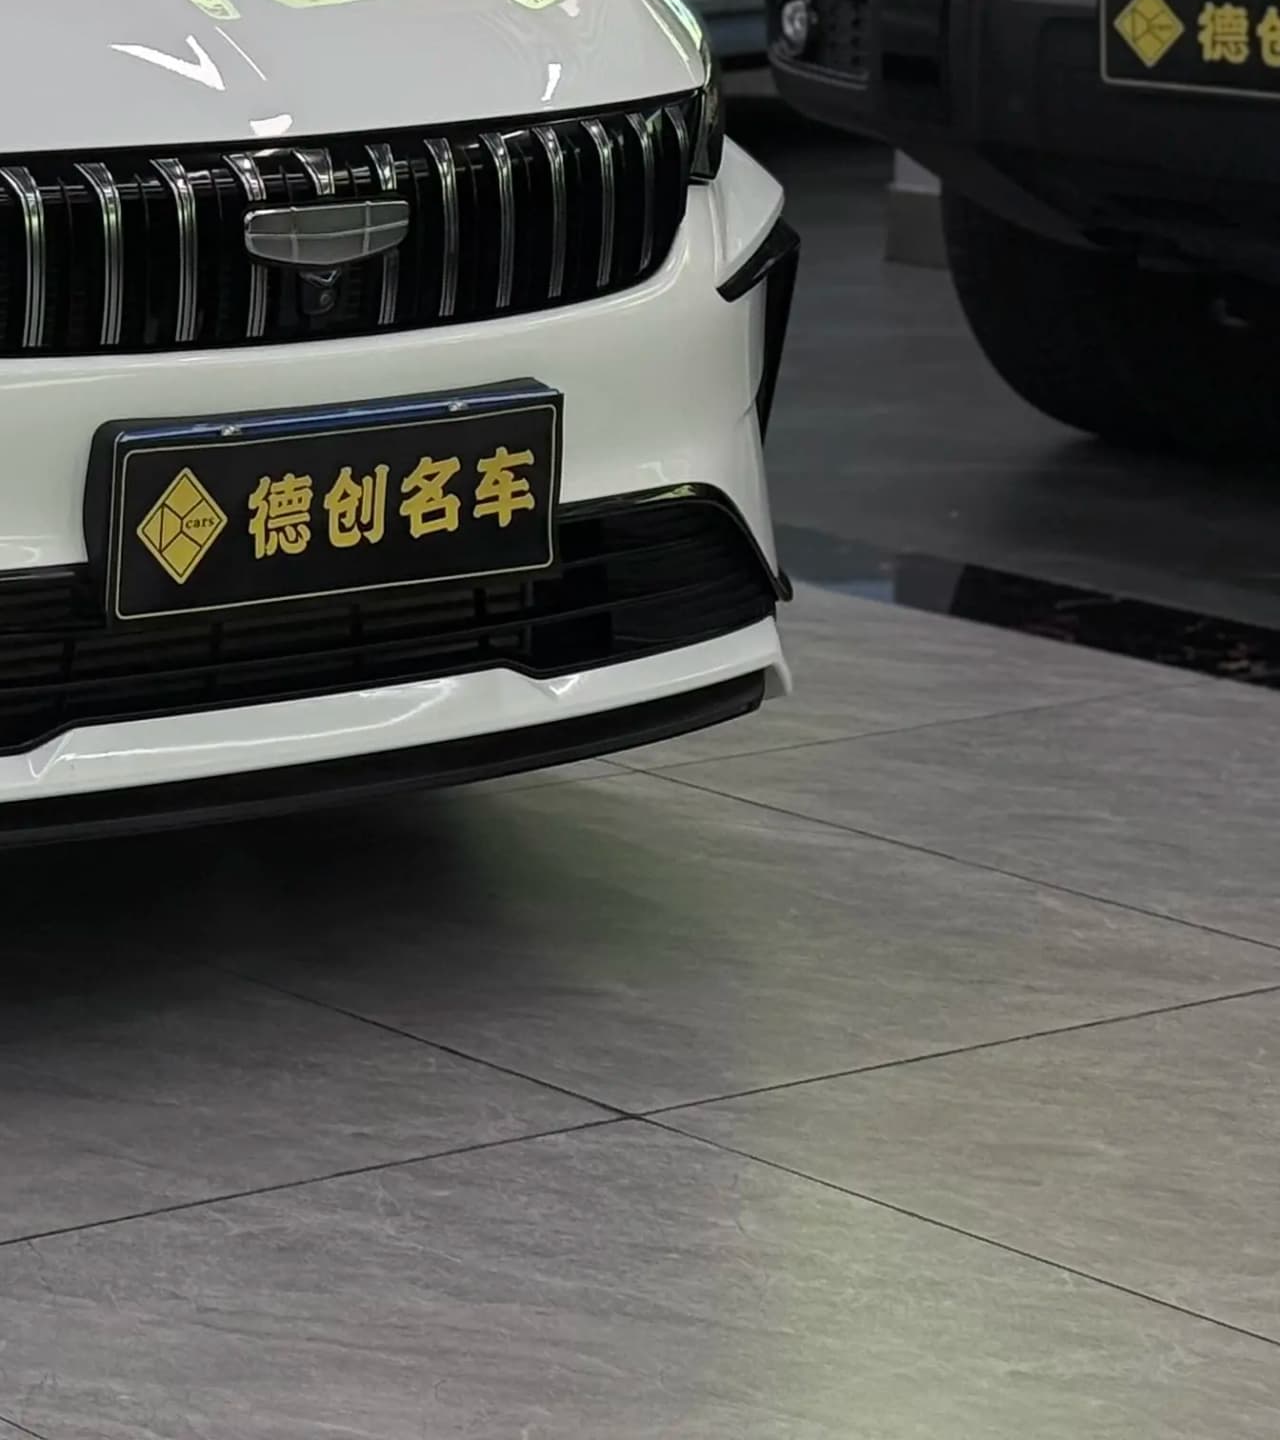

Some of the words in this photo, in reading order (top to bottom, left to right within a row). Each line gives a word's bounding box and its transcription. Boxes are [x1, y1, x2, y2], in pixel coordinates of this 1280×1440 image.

[185, 517, 215, 530] cars
[247, 445, 537, 560] 德创名车
